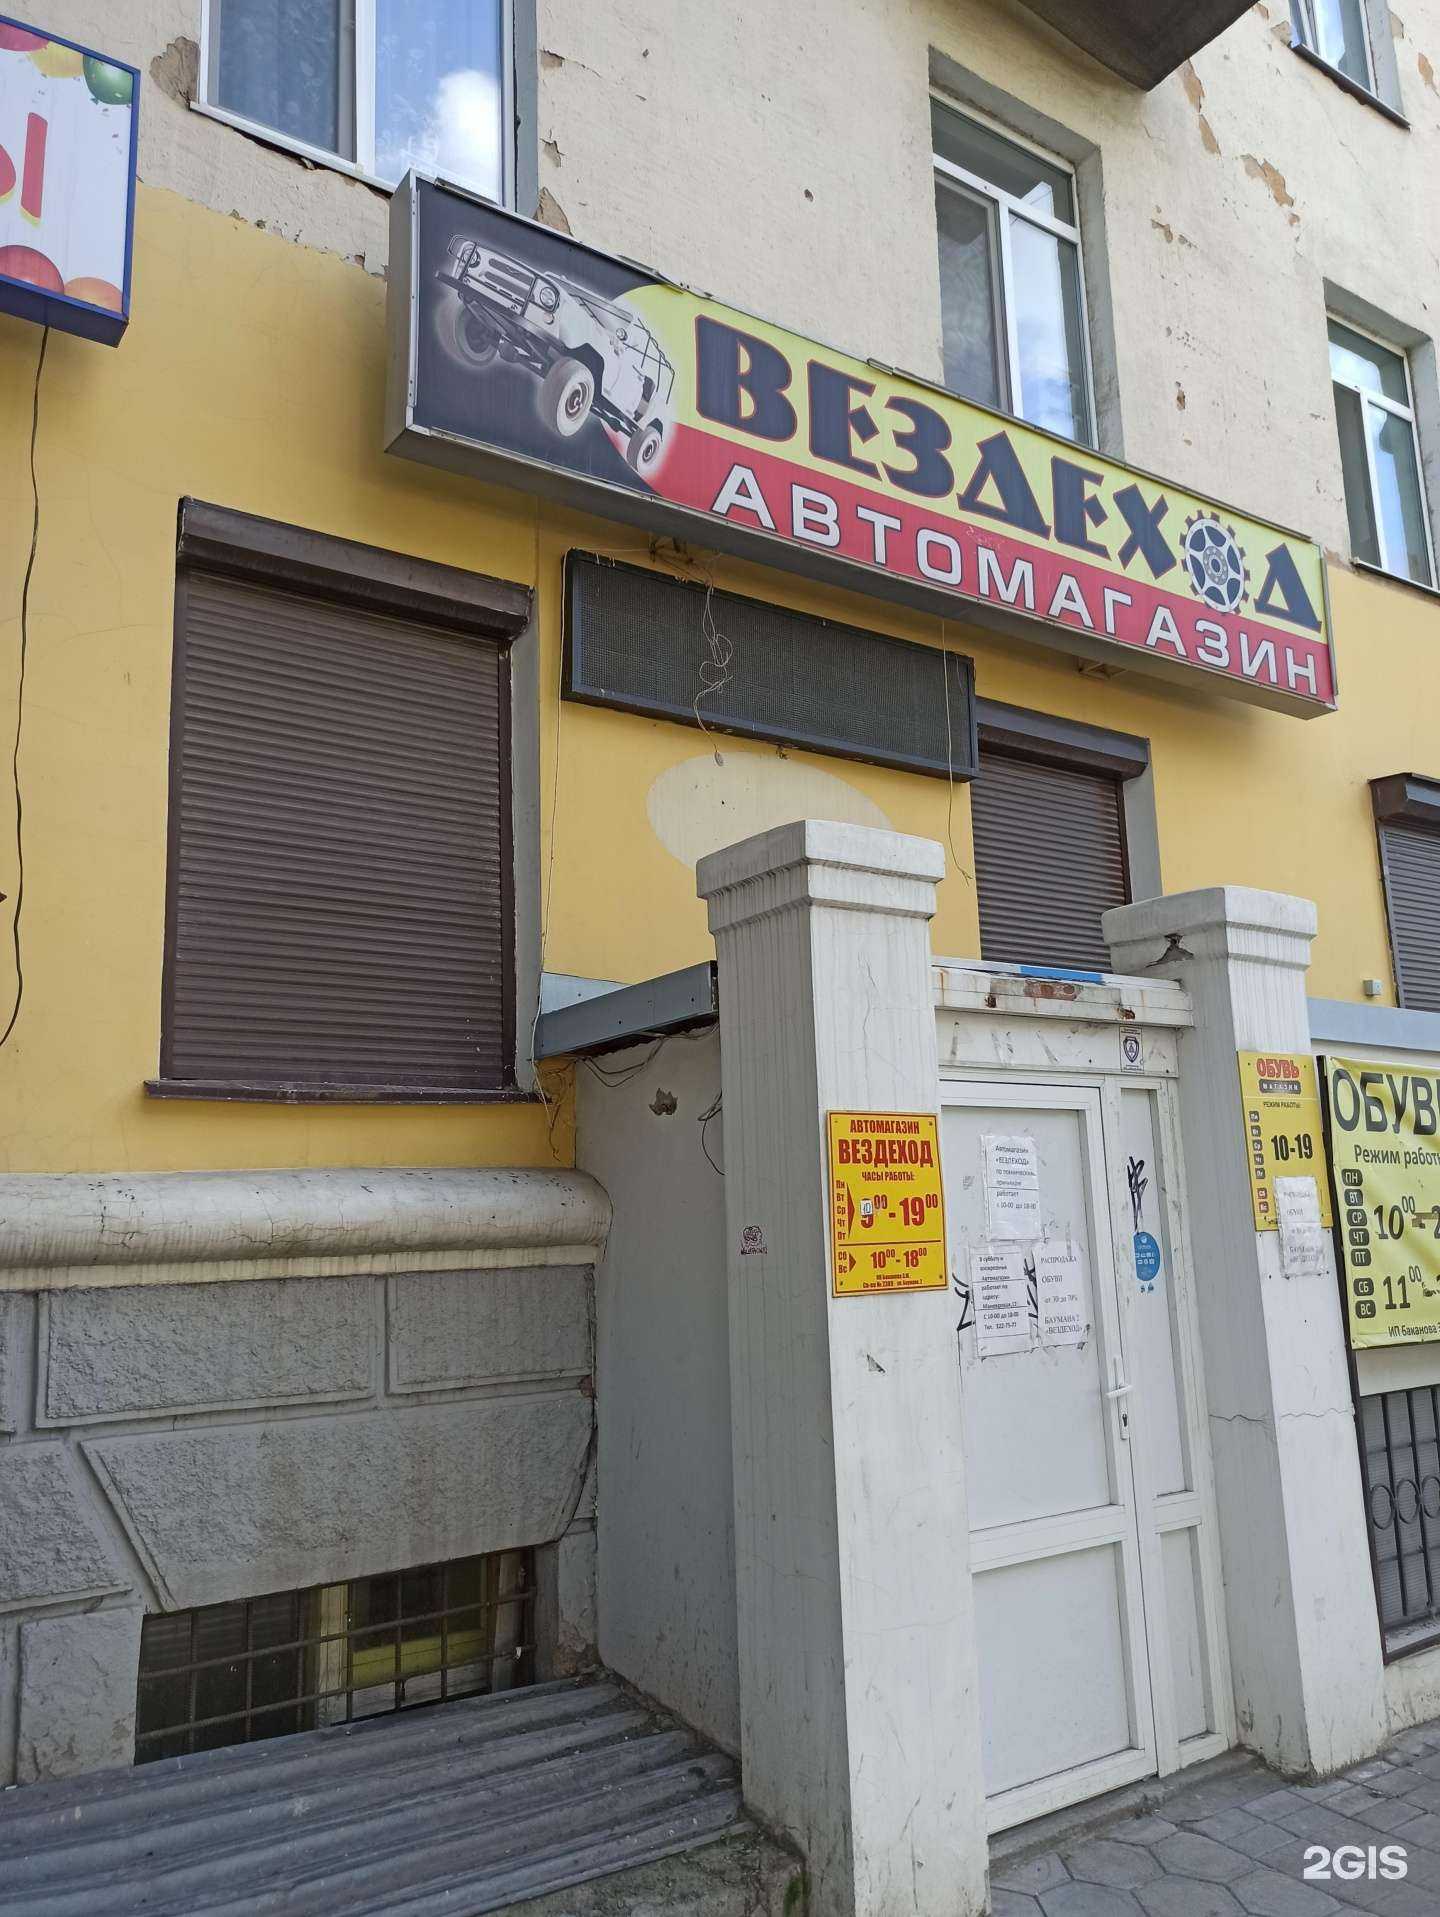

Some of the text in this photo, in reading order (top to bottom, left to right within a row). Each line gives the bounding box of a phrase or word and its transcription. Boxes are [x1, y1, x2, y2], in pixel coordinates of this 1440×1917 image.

[695, 314, 1322, 635] ВЕЗДЕХОД
[711, 463, 1320, 696] АВТОМАГАЗИН
[1257, 1058, 1300, 1078] ОБУВЬ
[1262, 1083, 1299, 1091] МАГАЗИН
[1333, 1068, 1440, 1136] ОБУВ
[850, 1120, 920, 1134] АВТОМАГАЗИН
[1271, 1133, 1313, 1161] 10-19
[838, 1139, 933, 1168] ВЕЗДЕХОД
[1354, 1144, 1401, 1164] Режим
[862, 1171, 915, 1182] ЧАСЫ РАБОТЫ:
[1345, 1172, 1358, 1184] ПН
[1350, 1192, 1359, 1204] ВТ
[837, 1206, 846, 1215] Ср
[1351, 1211, 1363, 1223] СР
[1353, 1231, 1364, 1243] ЧТ
[1041, 1255, 1077, 1264] РАСПРОДАЖА
[1354, 1252, 1366, 1264] ПТ
[1358, 1282, 1370, 1293] СБ
[1360, 1303, 1372, 1316] ВС
[1388, 1325, 1400, 1338] ИП
